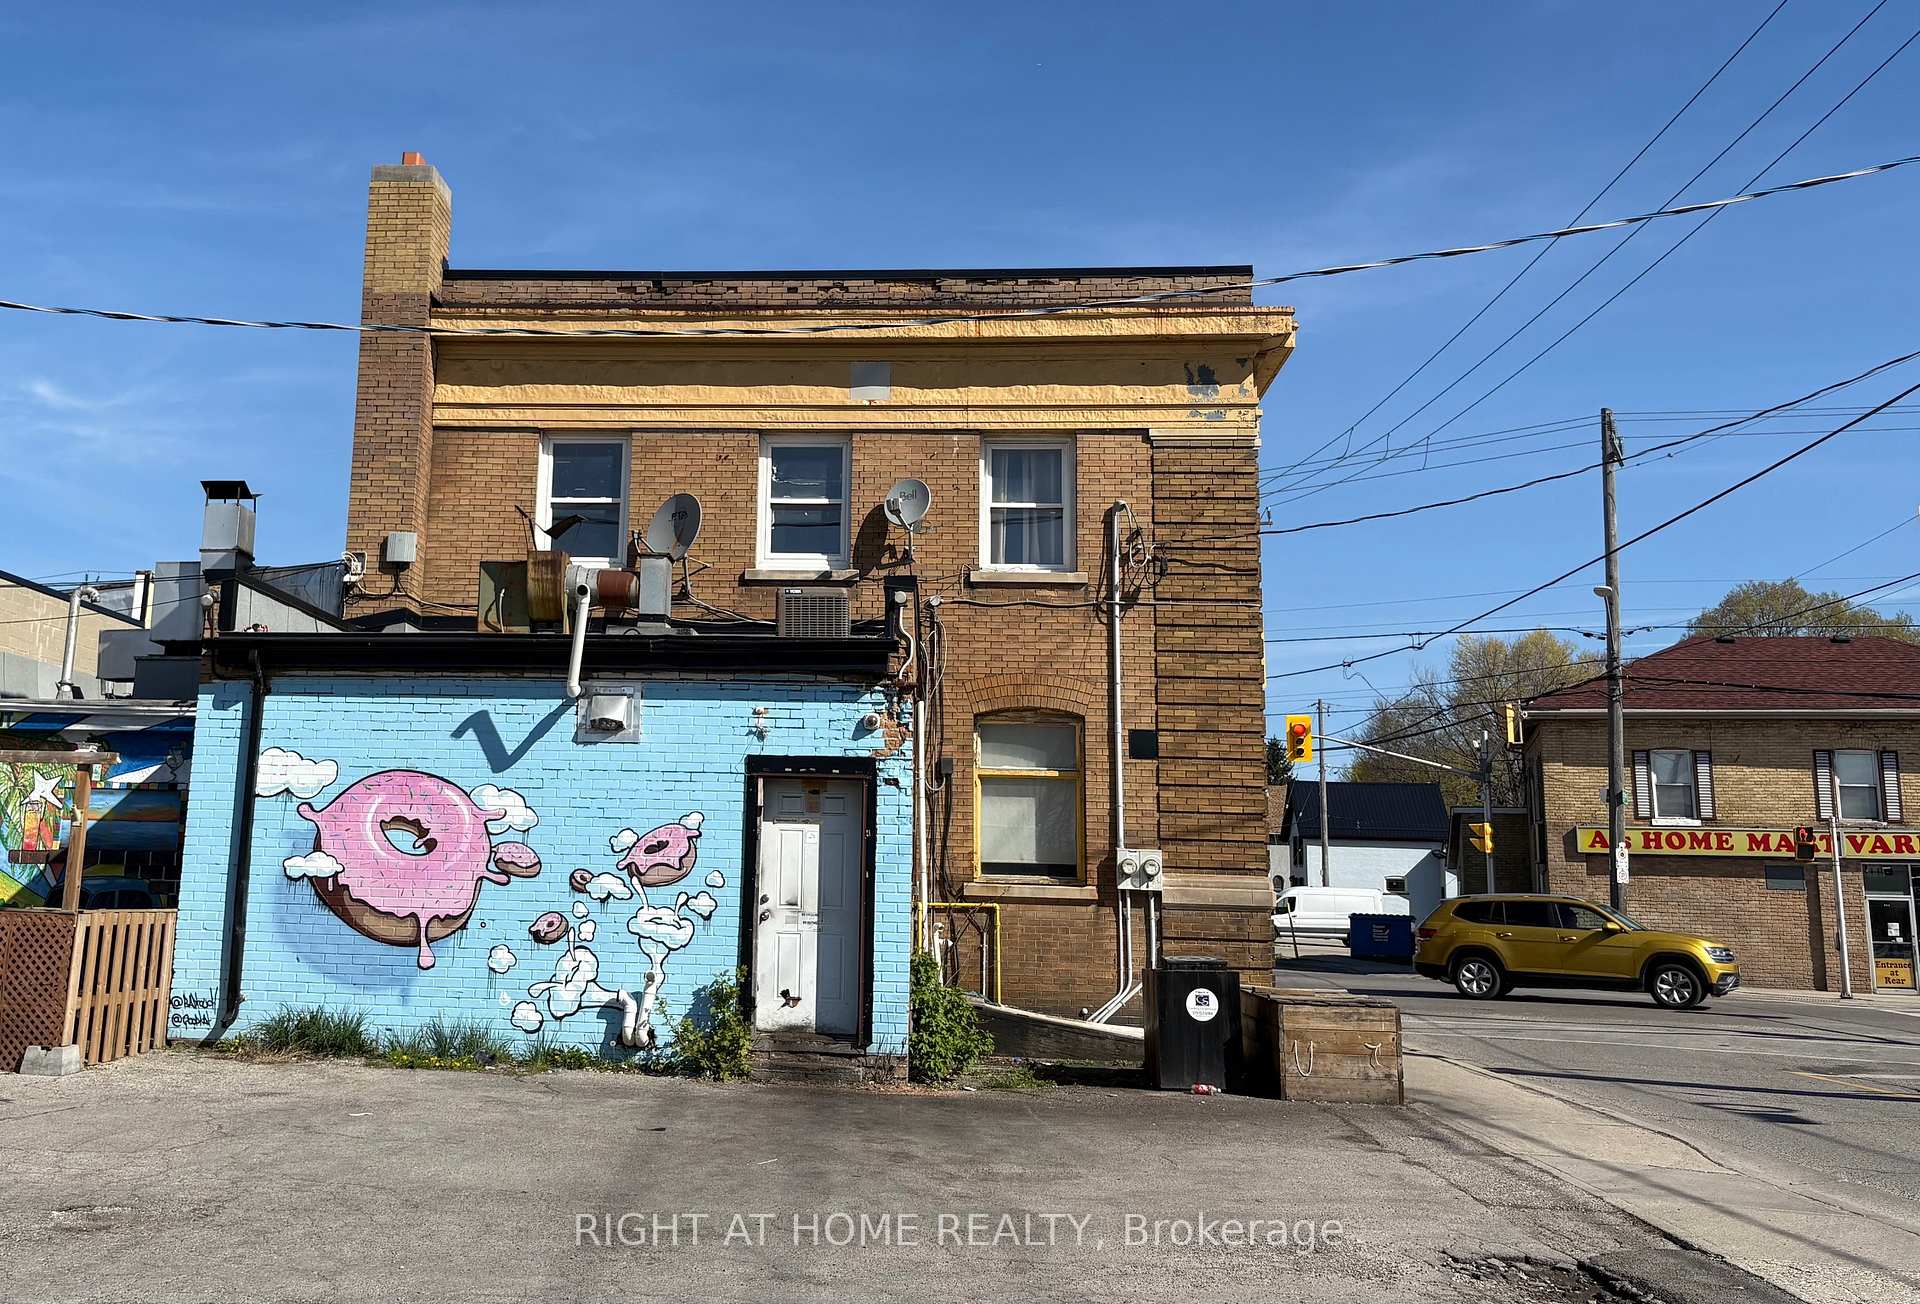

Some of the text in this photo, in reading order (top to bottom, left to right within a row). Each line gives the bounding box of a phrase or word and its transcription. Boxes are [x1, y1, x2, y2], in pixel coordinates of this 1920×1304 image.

[900, 490, 917, 501] Bell
[1641, 831, 1735, 851] HOME
[1876, 960, 1912, 969] Entrance
[1889, 969, 1899, 977] at
[1884, 976, 1906, 985] Rear
